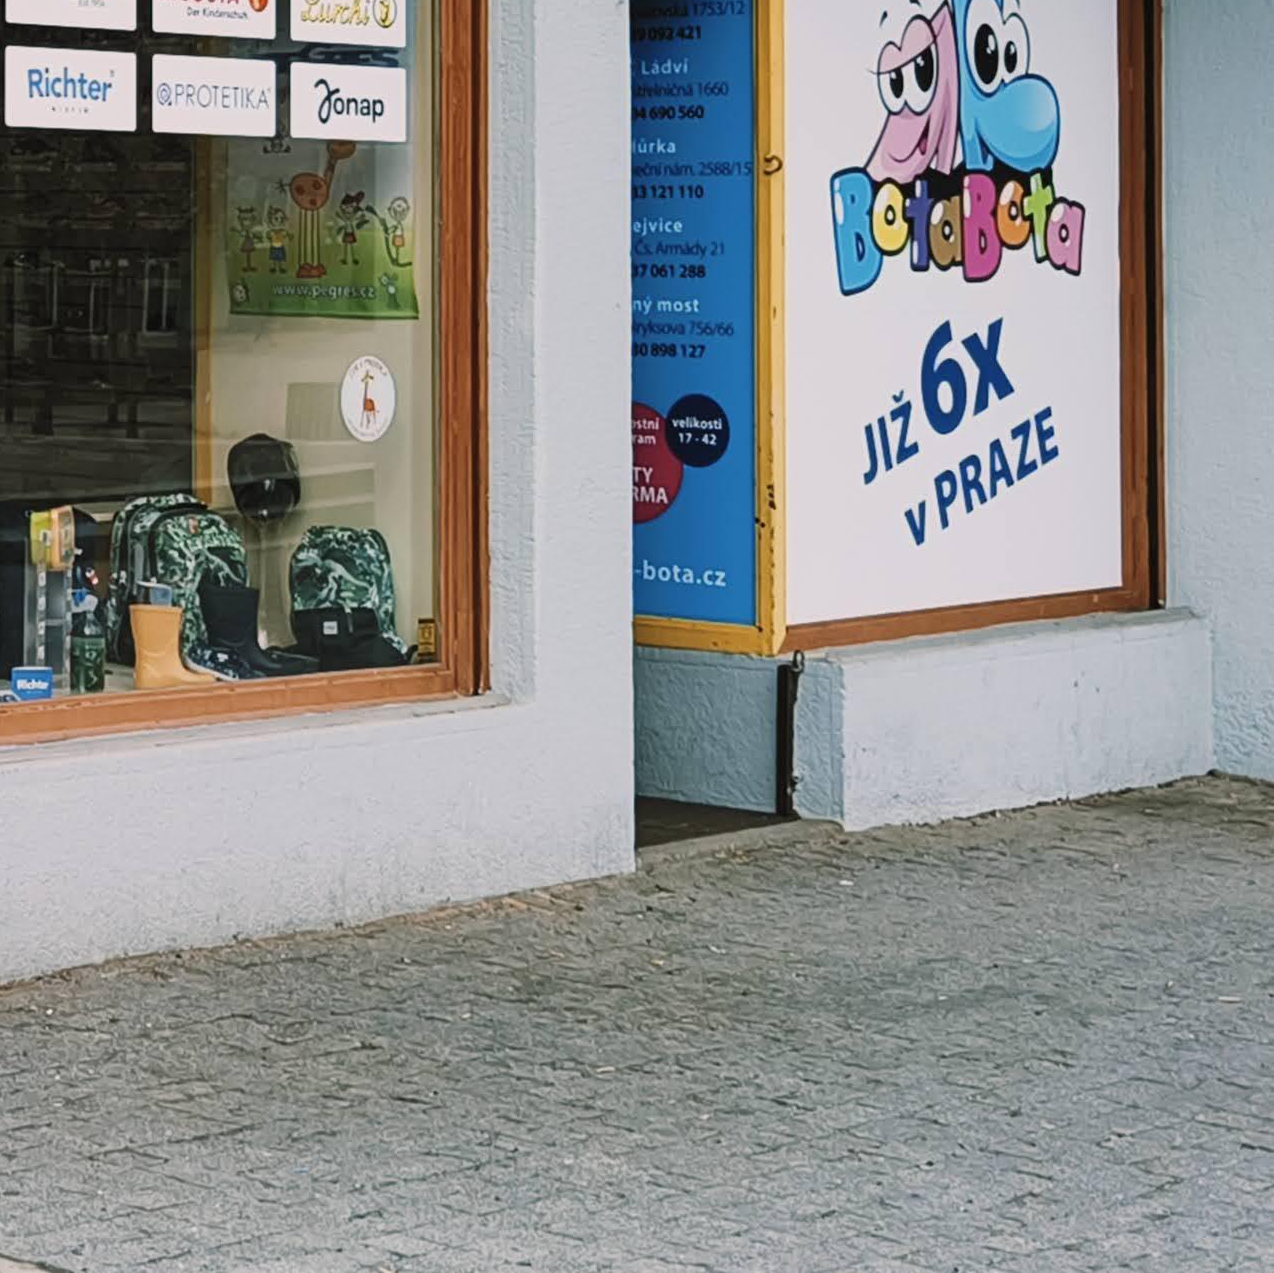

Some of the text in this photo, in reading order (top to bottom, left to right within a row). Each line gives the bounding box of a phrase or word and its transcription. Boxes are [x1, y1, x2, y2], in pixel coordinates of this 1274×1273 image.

[675, 25, 701, 40] 421
[27, 67, 112, 102] Richter
[698, 81, 730, 96] 1660
[174, 83, 269, 110] PROTETIKA
[677, 105, 704, 119] 560
[651, 185, 673, 199] 121
[678, 184, 704, 199] 110
[711, 241, 725, 256] 21
[650, 264, 675, 279] 061
[657, 298, 699, 313] most
[680, 343, 706, 359] 127
[671, 416, 723, 430] velikosti
[678, 432, 692, 444] 17
[701, 434, 717, 446] 42
[863, 389, 920, 486] JIŽ
[934, 406, 1059, 530] PRAZE
